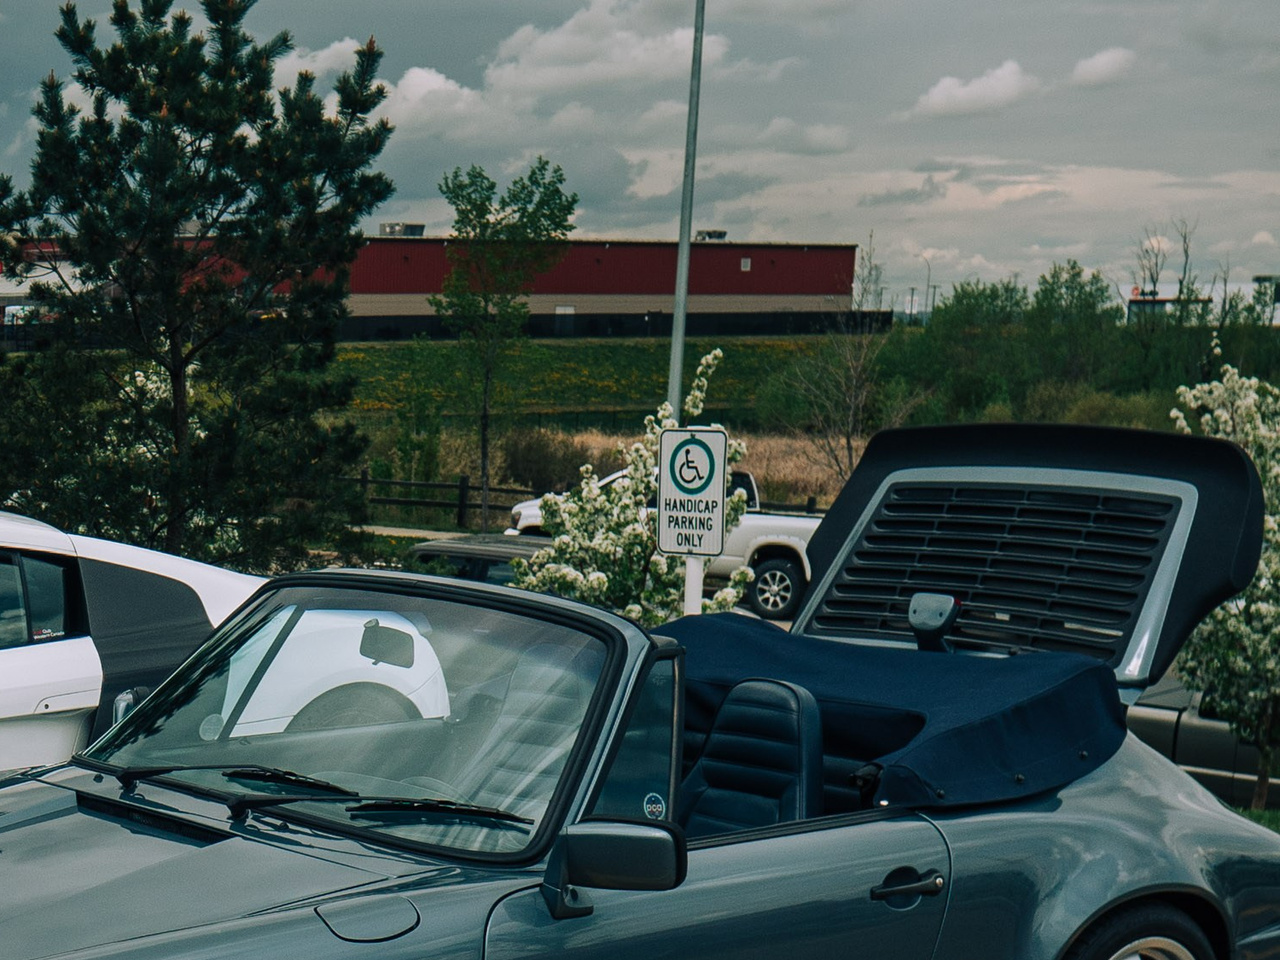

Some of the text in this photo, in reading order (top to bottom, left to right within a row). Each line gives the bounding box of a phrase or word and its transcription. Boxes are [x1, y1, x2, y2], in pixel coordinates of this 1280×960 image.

[665, 498, 718, 514] HANDICAP
[668, 515, 713, 531] PARKING
[676, 532, 703, 547] ONLY
